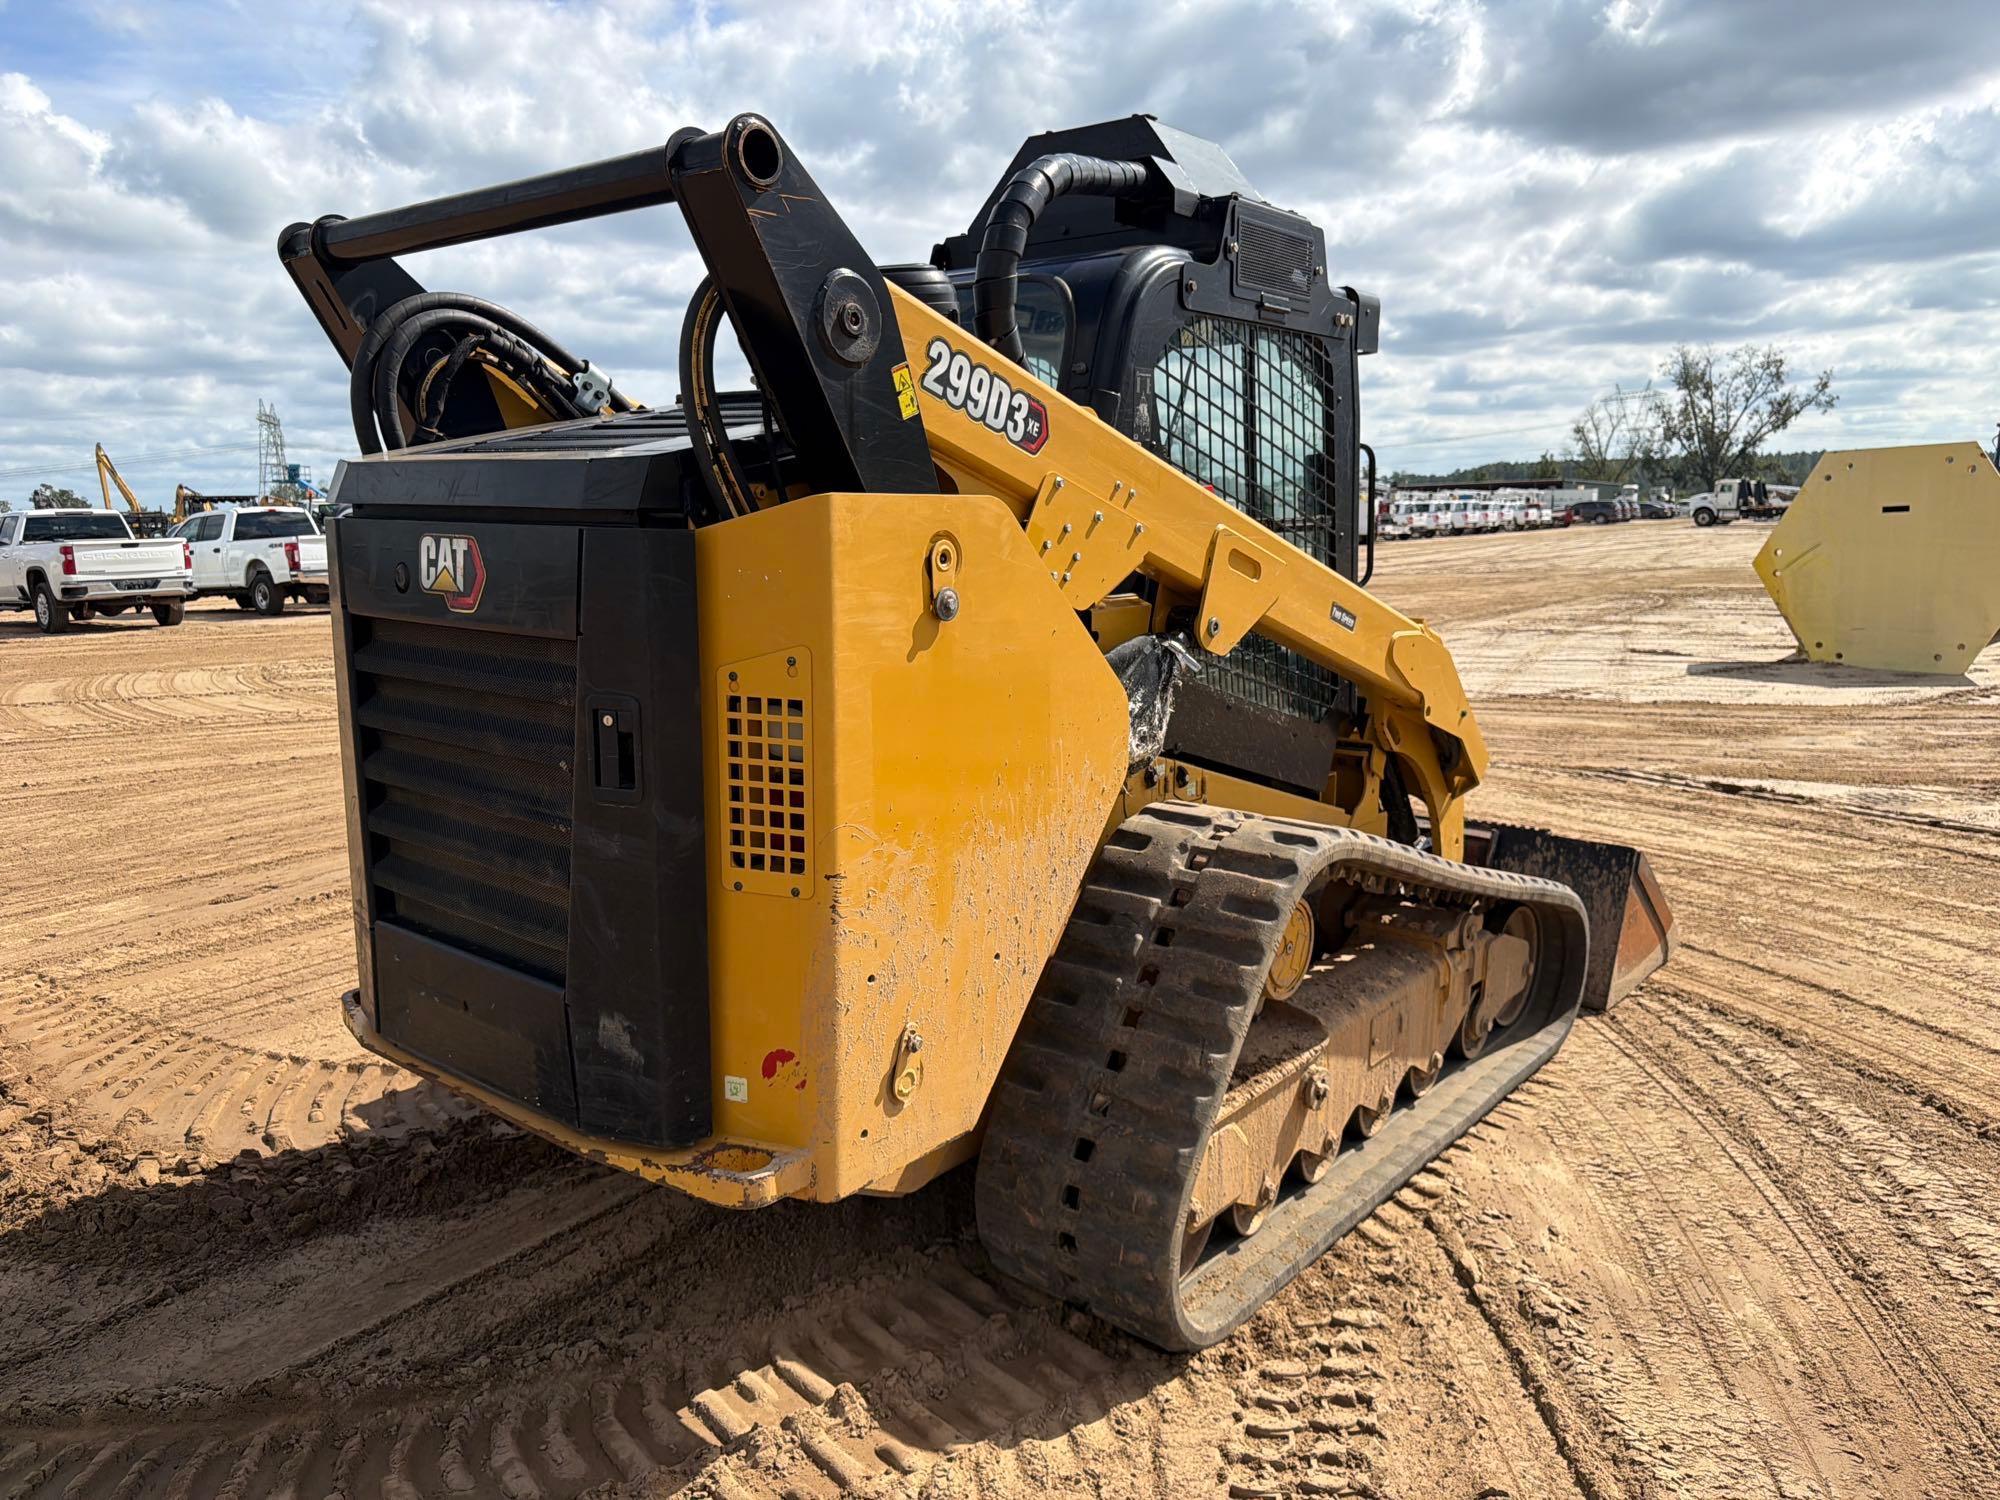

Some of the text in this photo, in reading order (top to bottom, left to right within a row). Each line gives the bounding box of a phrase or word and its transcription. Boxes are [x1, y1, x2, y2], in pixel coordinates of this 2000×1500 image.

[922, 339, 1041, 443] 299D3 XE
[420, 535, 469, 593] CAT
